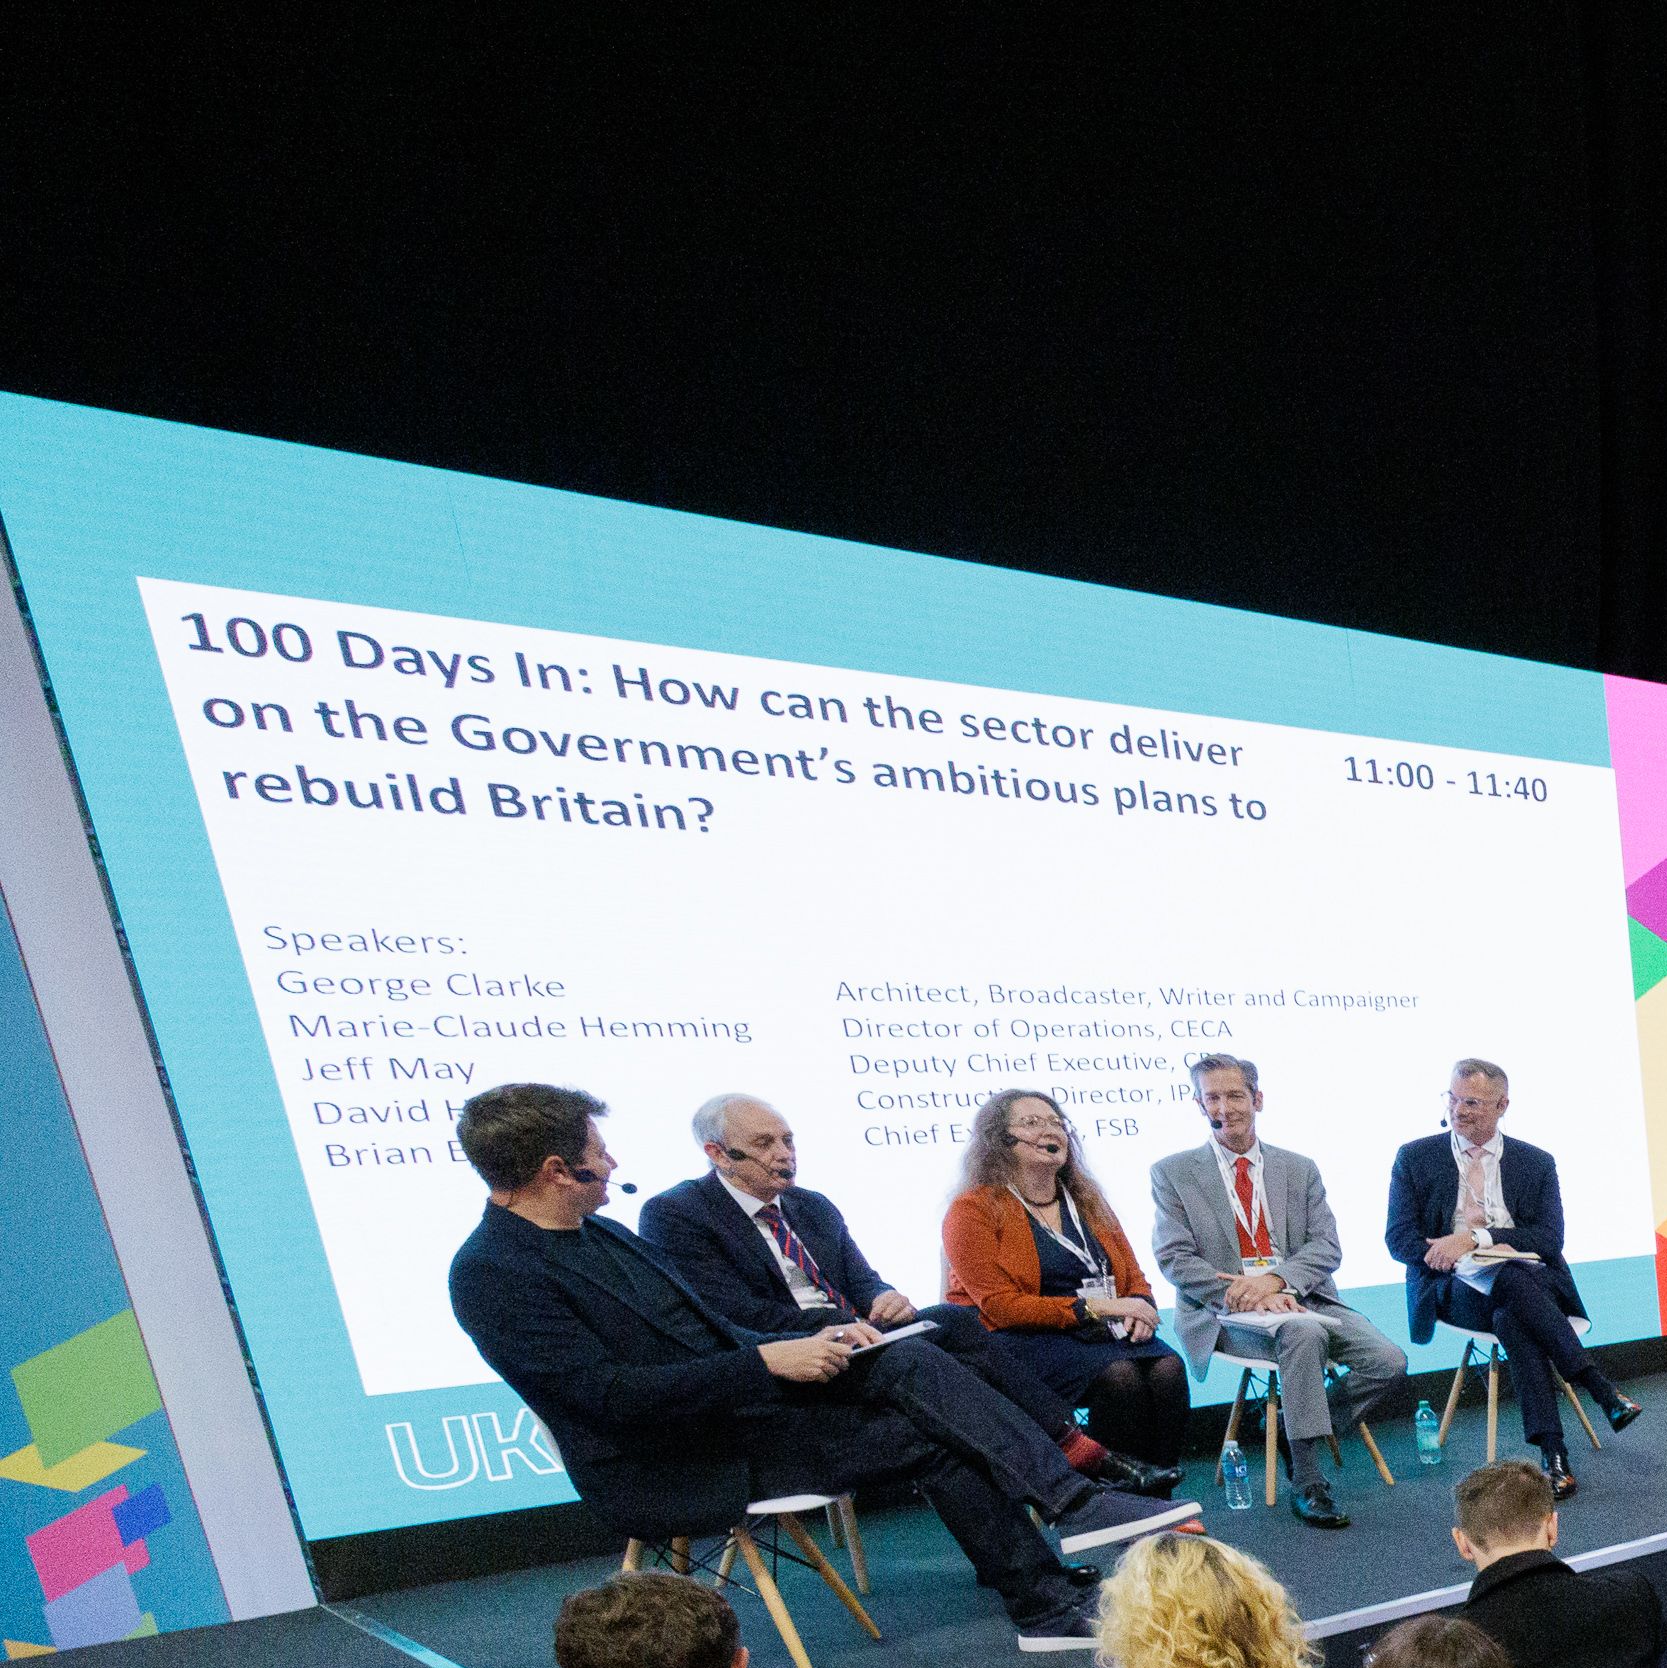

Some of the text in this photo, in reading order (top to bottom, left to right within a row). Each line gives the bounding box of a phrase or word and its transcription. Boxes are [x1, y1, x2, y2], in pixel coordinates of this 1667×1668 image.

[180, 612, 1244, 768] 100 Days In: How can the sector deliver
[201, 696, 1269, 822] on the Government’s ambitious plans to
[1343, 755, 1436, 792] 11:00
[1465, 769, 1549, 804] 11:40
[221, 765, 715, 833] rebuild Britain?
[263, 925, 468, 955] Speakers:
[276, 970, 566, 1001] George Clarke
[835, 981, 1419, 1011] Architect, Broadcaster, Writer and Campaigner
[289, 1014, 753, 1043] Marie-Claude Hemming
[842, 1016, 1233, 1043] Director of Operations, CECA
[302, 1056, 475, 1084] Jeff May
[849, 1053, 957, 1078] Deputy
[966, 1052, 1038, 1073] Chief
[1046, 1052, 1177, 1075] Executive,
[857, 1088, 1001, 1111] Construc
[1051, 1084, 1164, 1106] Director,
[314, 1100, 431, 1126] David
[863, 1123, 940, 1146] Chief
[1095, 1118, 1140, 1138] FSB
[325, 1142, 433, 1168] Brian
[385, 1407, 564, 1491] UK
